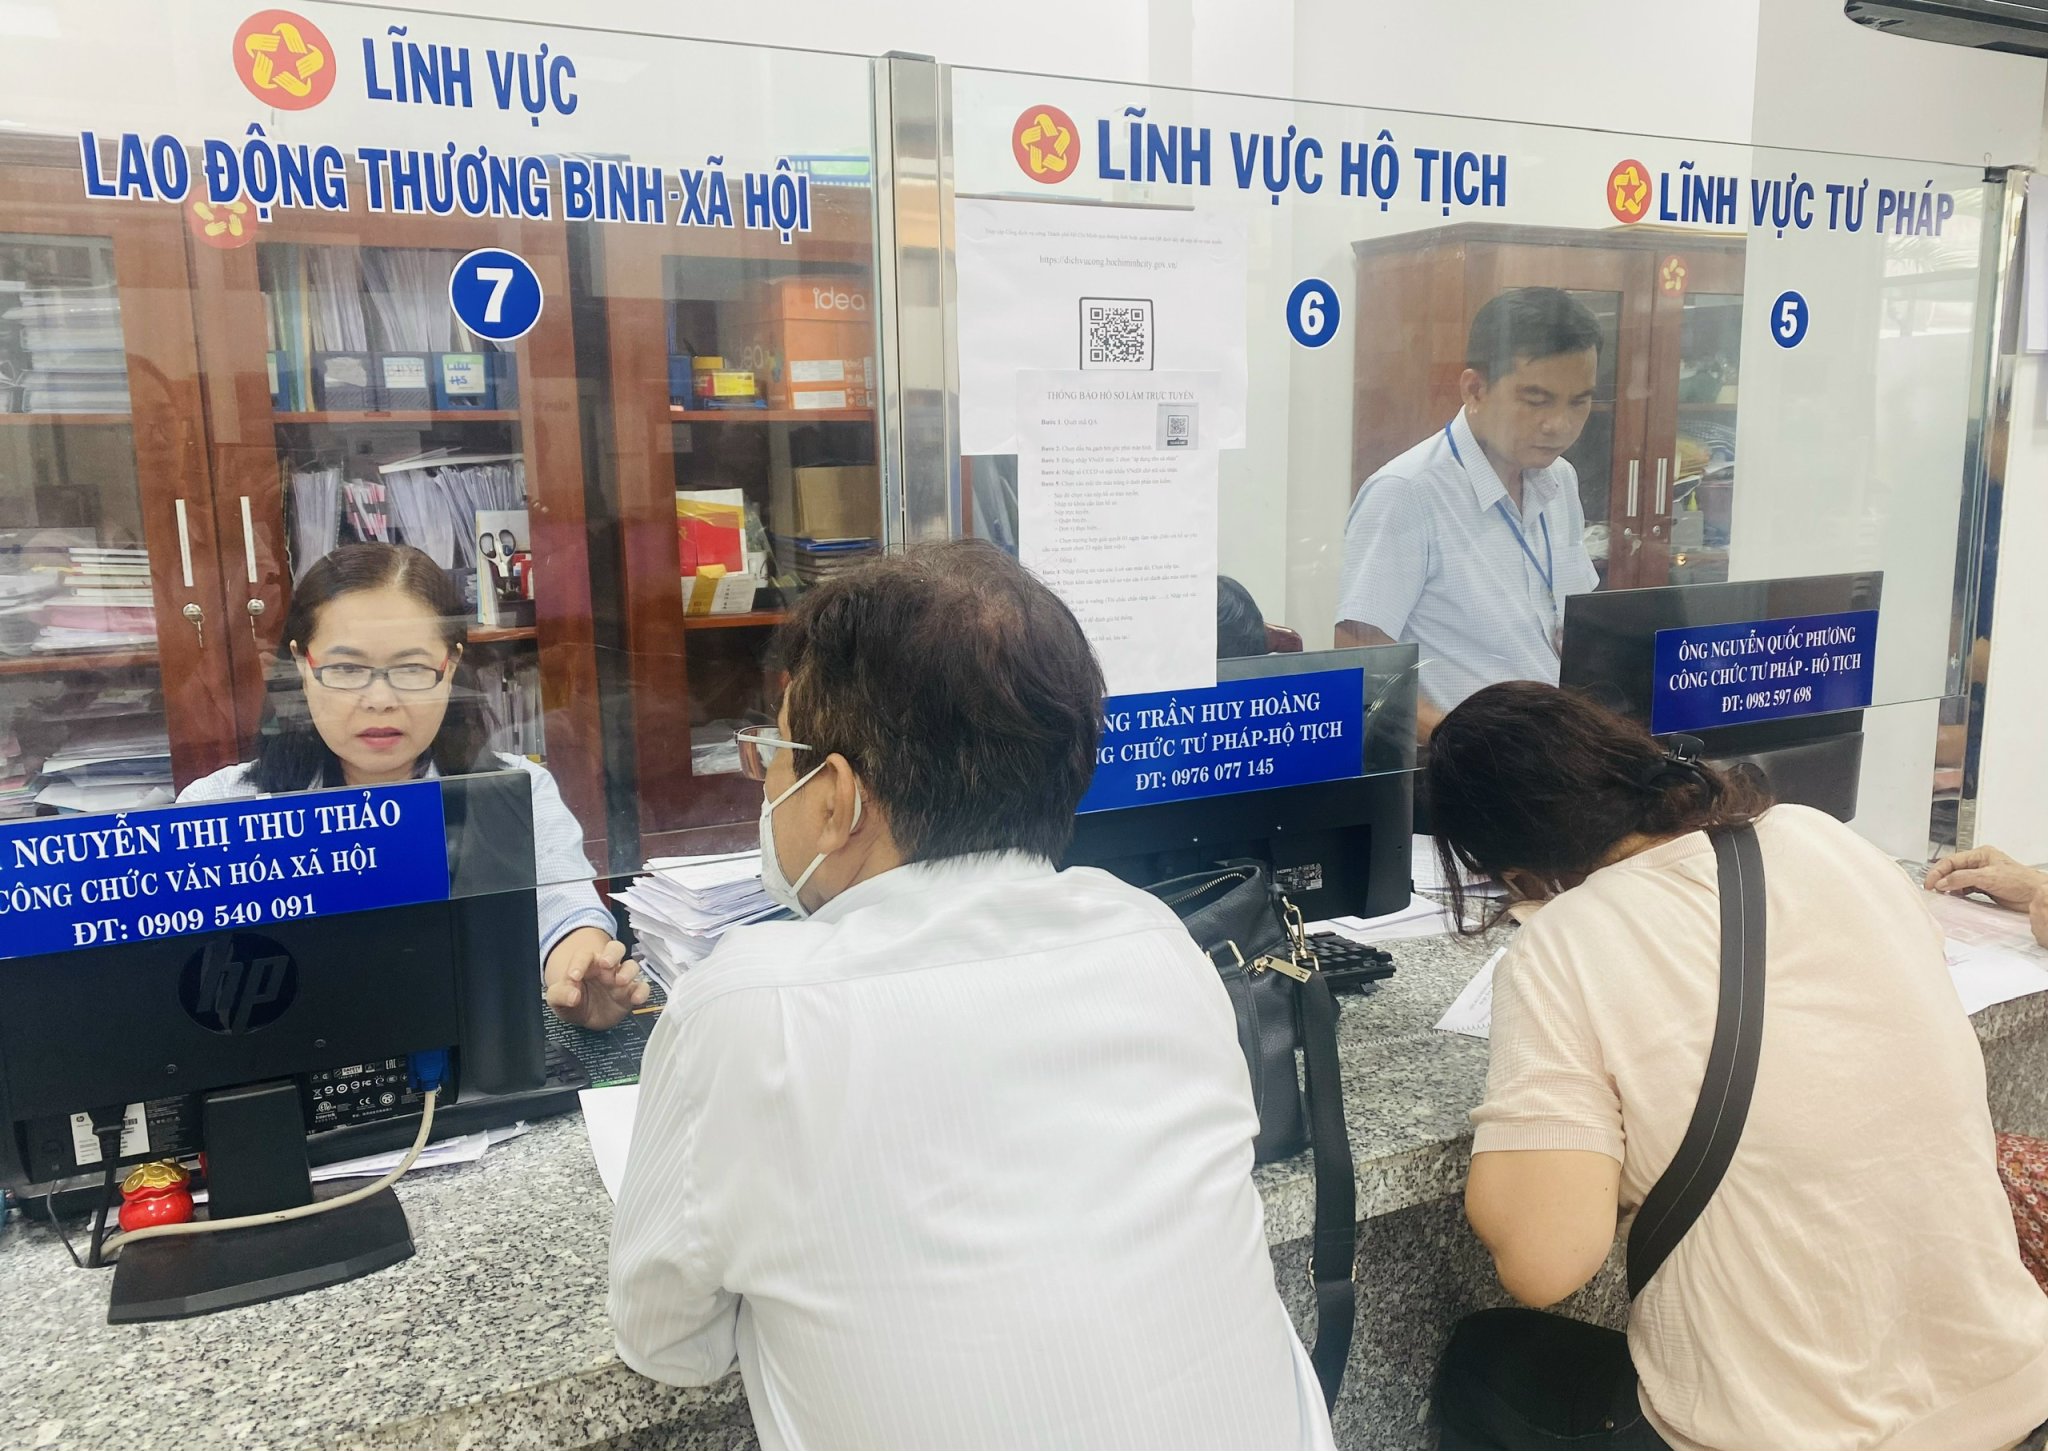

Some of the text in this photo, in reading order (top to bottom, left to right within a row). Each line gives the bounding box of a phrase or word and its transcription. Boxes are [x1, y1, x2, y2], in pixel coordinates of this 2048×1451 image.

[363, 26, 578, 127] LĨNH VỰC
[82, 131, 189, 200] LAO
[205, 123, 347, 219] ĐỘNG
[358, 142, 549, 217] THƯƠNG
[745, 156, 809, 241] HỘI
[1098, 107, 1507, 216] LĨNH VỰC HỘ TỊCH
[1659, 161, 1954, 238] LĨNH VỰC TƯ PHÁP
[478, 268, 514, 322] 7
[812, 286, 866, 312] idea
[1299, 290, 1325, 336] 6
[1779, 301, 1799, 339] 5
[1679, 625, 1856, 662] ÔNG NGUYỄN QUỐC PHƯƠNG
[1669, 669, 1708, 691] CÔNG
[1710, 662, 1748, 686] CHỨC
[1750, 660, 1769, 682] TƯ
[1769, 657, 1803, 678] PHÁP
[1811, 652, 1830, 678] HỘ
[1832, 653, 1862, 676] TỊCH
[1100, 690, 1321, 733] NG TRẦN HUY HOÀNG
[1722, 686, 1813, 713] ĐT: 0982 597 698
[1120, 736, 1176, 762] CHỨC
[1181, 731, 1208, 755] TƯ
[1212, 721, 1295, 752] PHÁP-HỘ
[1300, 720, 1343, 745] TỊCH
[1135, 757, 1275, 791] ĐT: 0976 077 145
[12, 790, 401, 870] NGUYỄN THỊ THU THẢO
[0, 843, 378, 915] CÔNG CHỨC VĂN HÓA XÃ HỘI
[72, 893, 317, 947] ĐT: 0909 540 091
[196, 933, 291, 1035] hp
